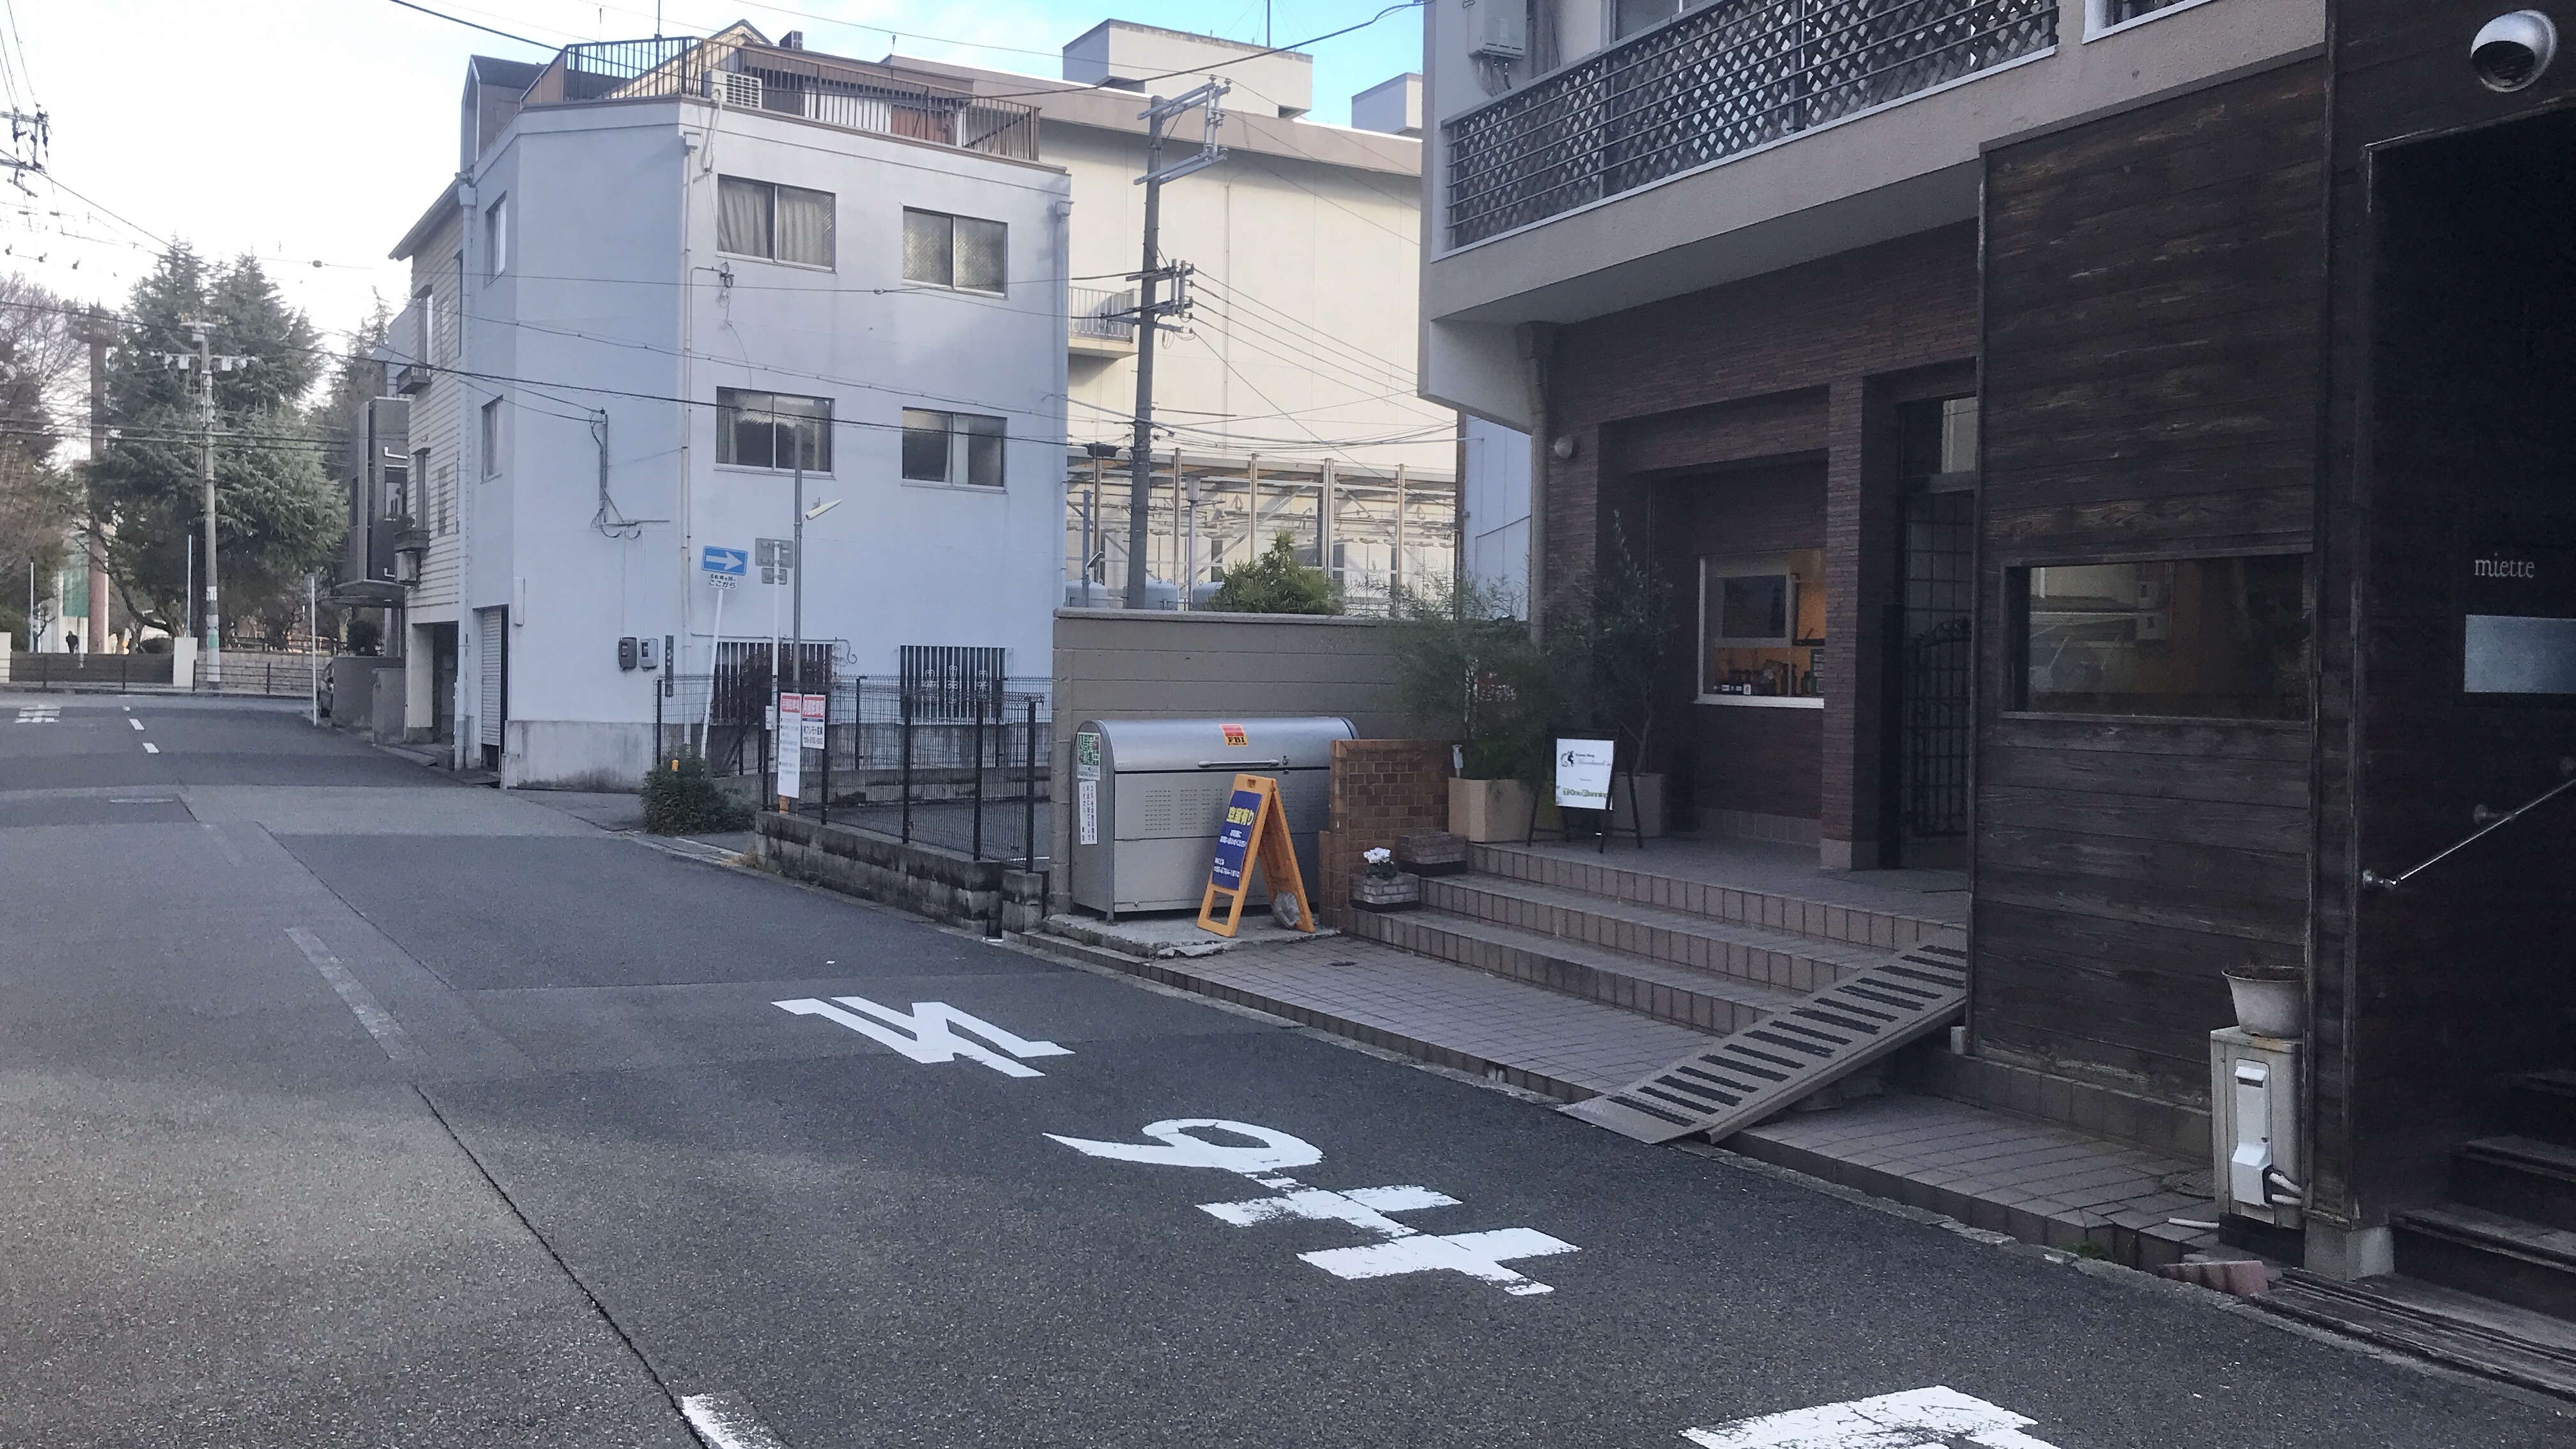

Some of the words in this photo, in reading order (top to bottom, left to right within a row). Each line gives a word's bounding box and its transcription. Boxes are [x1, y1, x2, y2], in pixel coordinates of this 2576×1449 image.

[2474, 552, 2535, 578] miette
[709, 579, 736, 589] ここから
[1226, 806, 1255, 826] 空室有り
